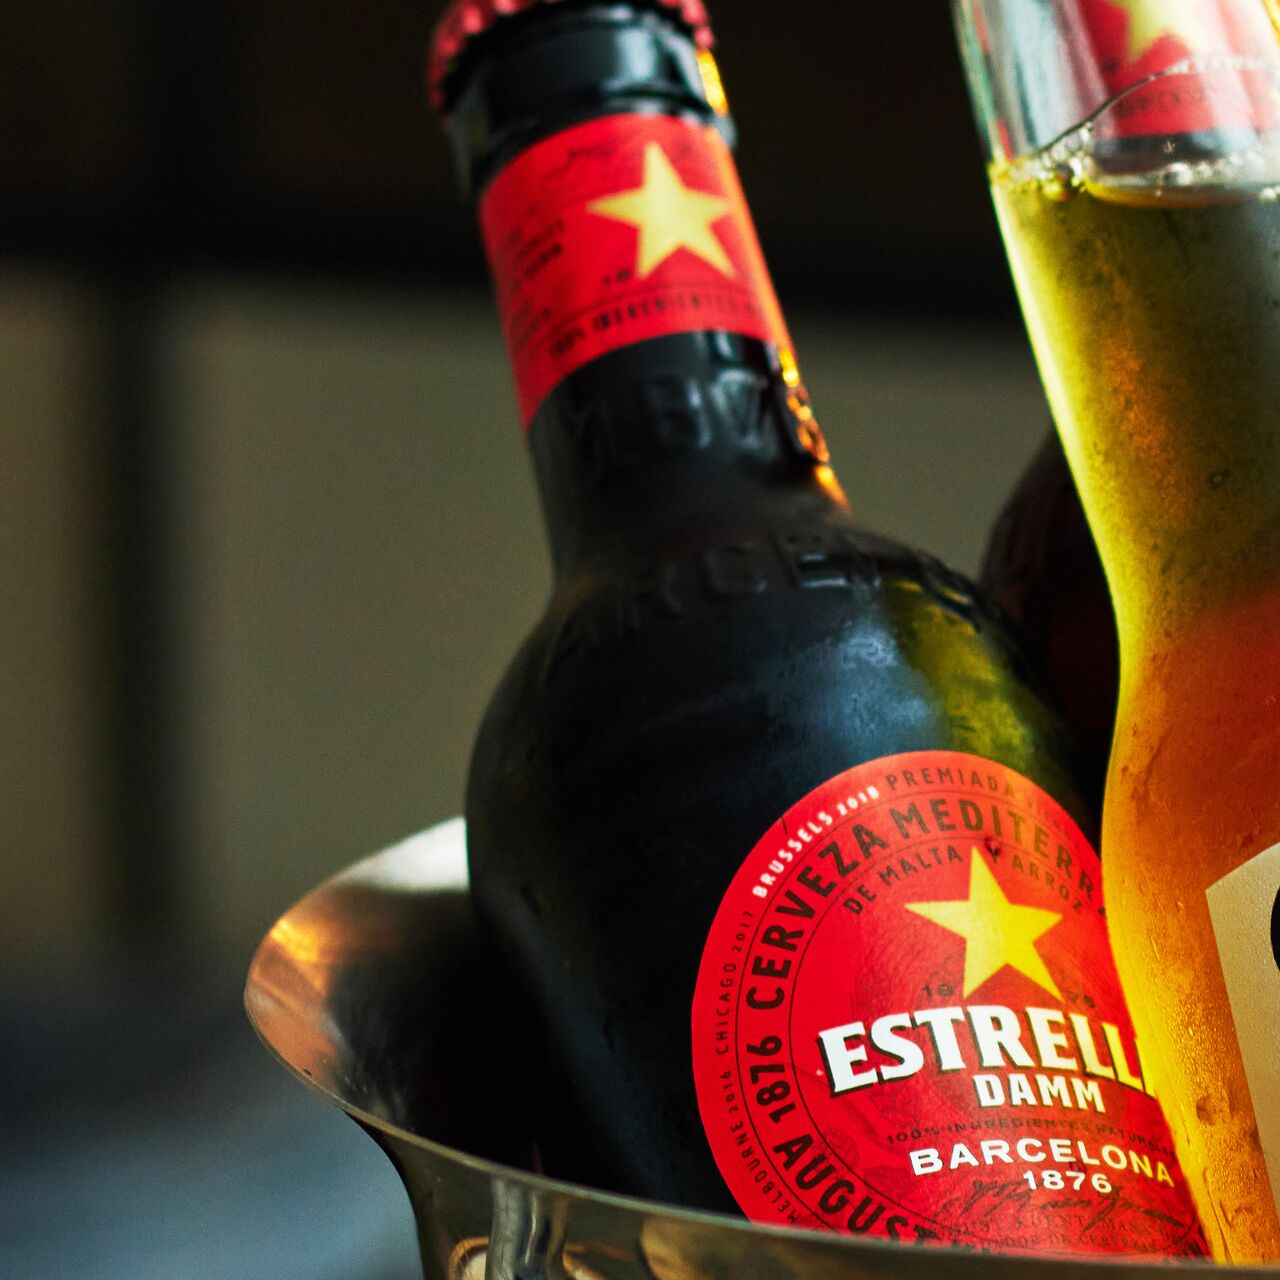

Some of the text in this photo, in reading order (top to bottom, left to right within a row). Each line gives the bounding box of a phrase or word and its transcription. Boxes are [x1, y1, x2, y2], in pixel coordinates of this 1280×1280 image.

[746, 823, 889, 1011] CERVEZA
[889, 798, 1107, 917] MEDITERR
[842, 883, 878, 916] DE
[877, 845, 964, 888] MALTA
[714, 963, 738, 1056] CHICAGO
[752, 811, 833, 899] BRUSSELS
[972, 1073, 1107, 1115] DAMM
[908, 1137, 1176, 1188] BARCELONA
[1022, 1169, 1114, 1194] 1876
